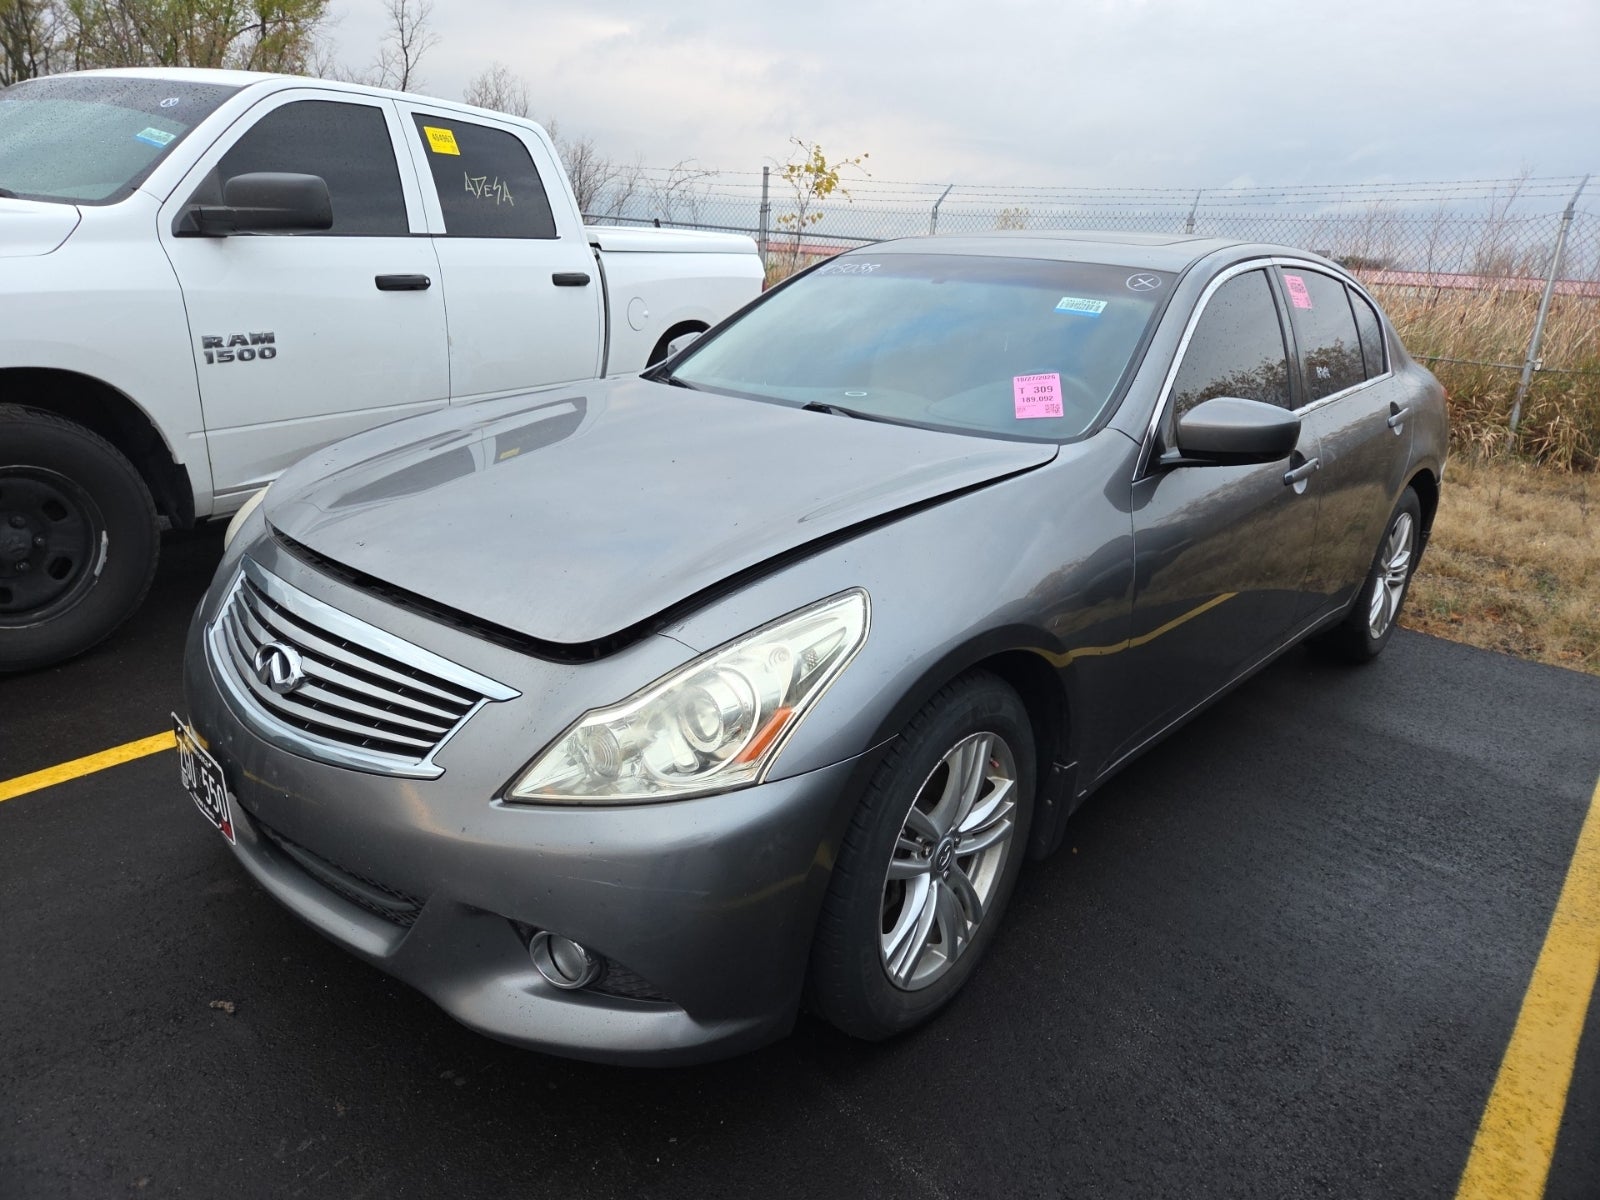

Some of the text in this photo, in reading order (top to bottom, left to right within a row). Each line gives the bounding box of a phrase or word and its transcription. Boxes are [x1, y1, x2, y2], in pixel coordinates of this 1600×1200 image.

[201, 332, 275, 349] RAM
[203, 347, 277, 364] 1500
[1033, 385, 1054, 394] 309
[201, 766, 228, 822] 550
